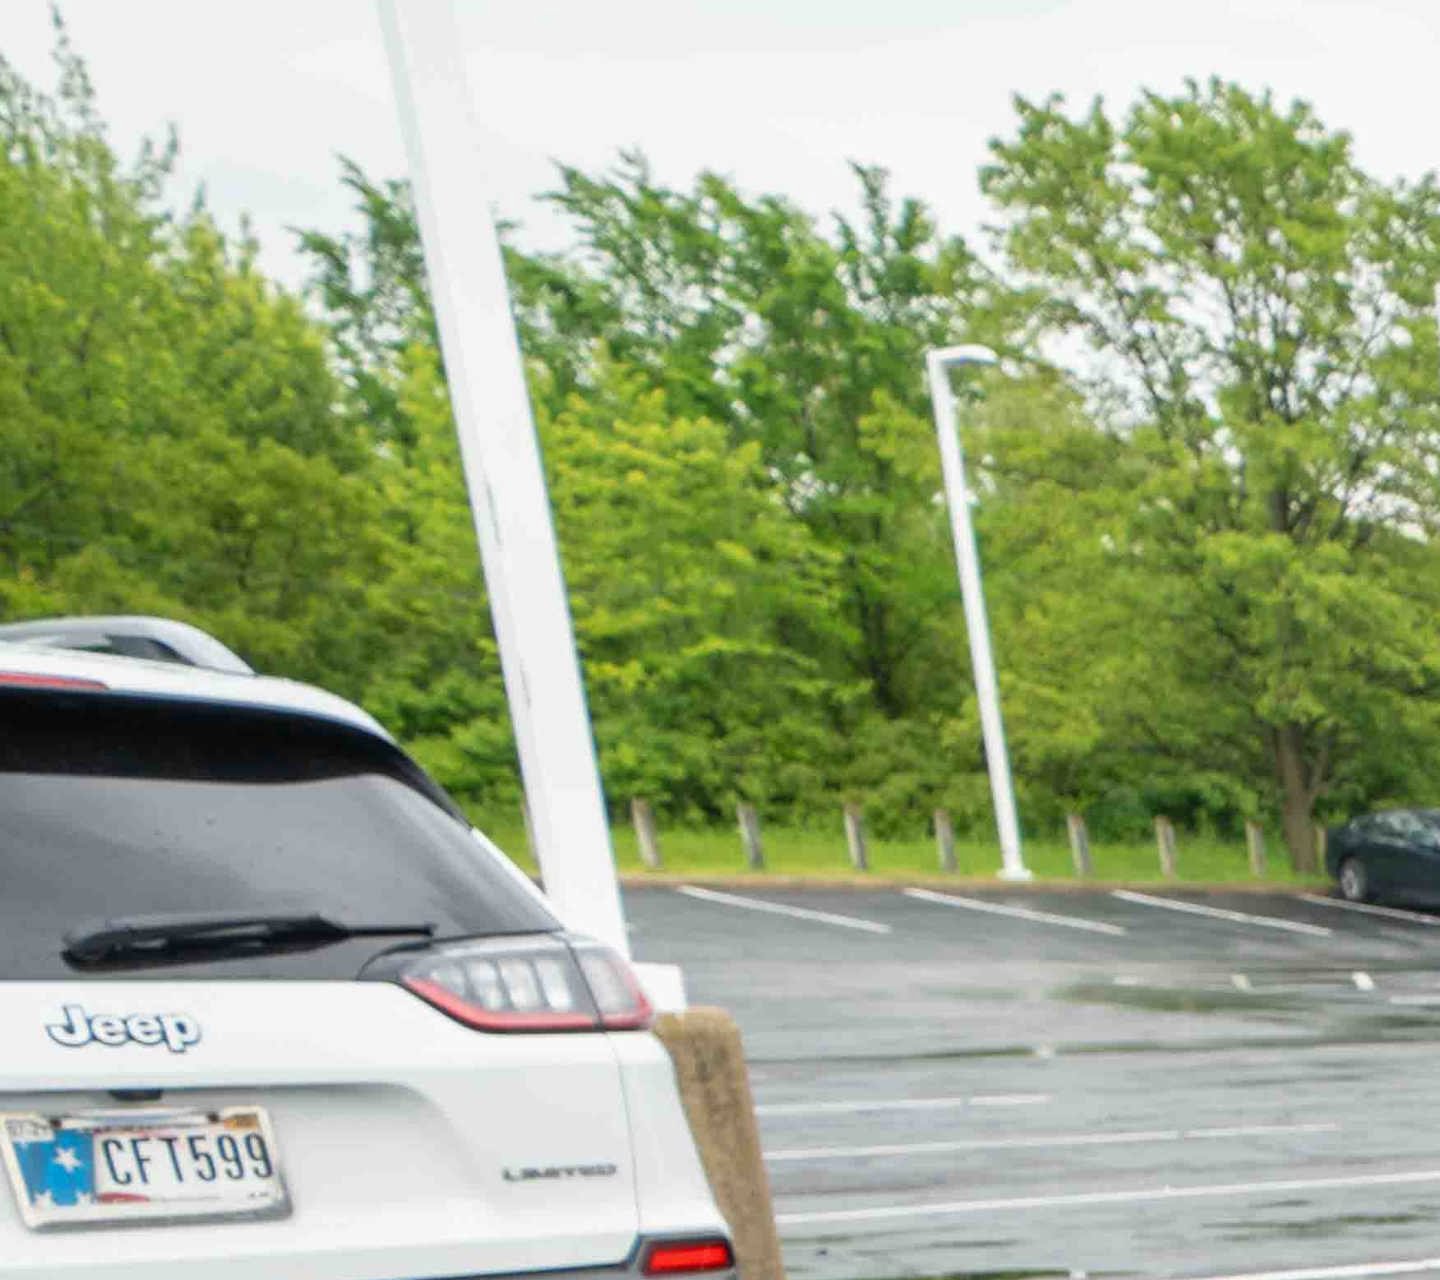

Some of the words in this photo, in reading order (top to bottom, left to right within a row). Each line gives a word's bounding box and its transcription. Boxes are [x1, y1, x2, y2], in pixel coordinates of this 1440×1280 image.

[45, 1004, 200, 1053] Jeep
[102, 1133, 273, 1186] CFT599
[502, 1163, 618, 1182] LIMITED
